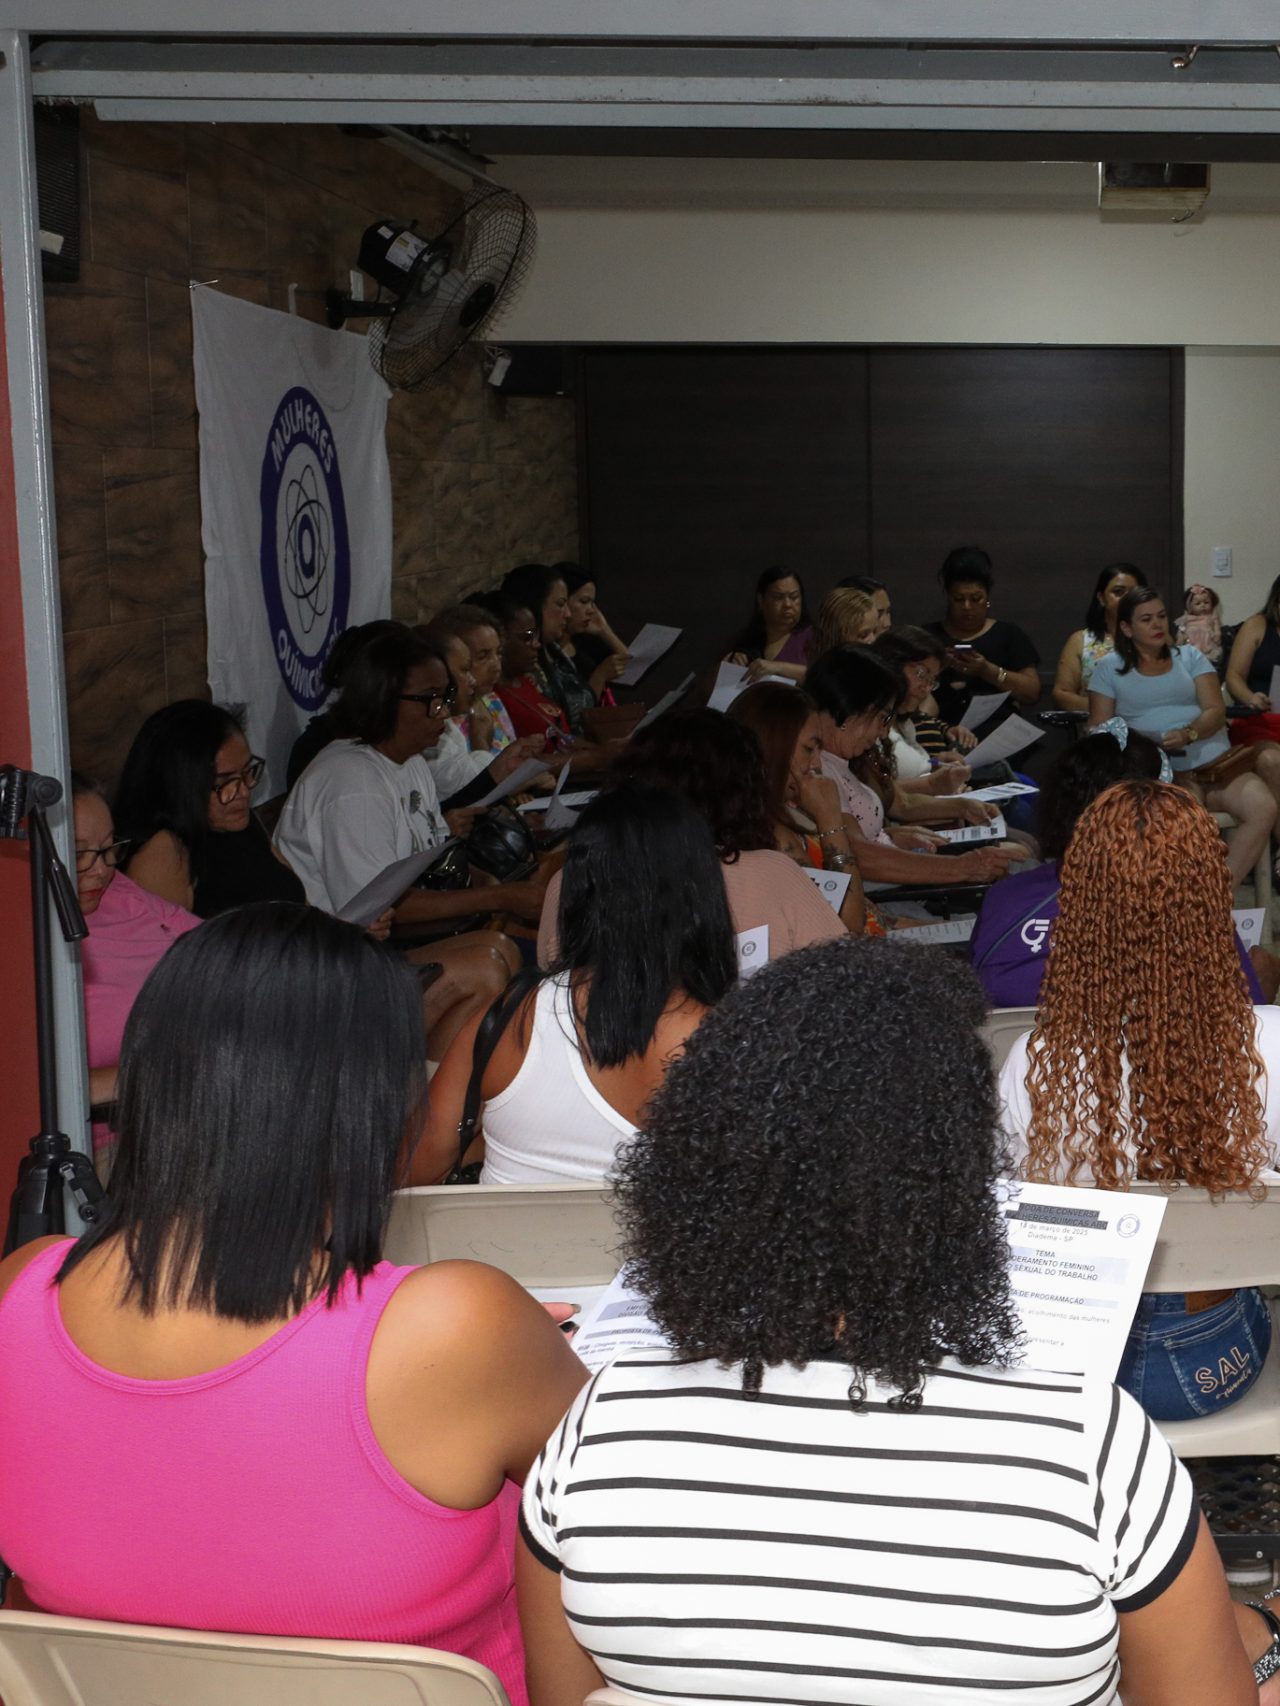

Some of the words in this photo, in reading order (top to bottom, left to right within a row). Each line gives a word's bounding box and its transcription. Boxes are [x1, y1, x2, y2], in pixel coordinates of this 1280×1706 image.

[271, 399, 334, 473] MULHERES
[1035, 1249, 1056, 1258] TEMA
[1013, 1264, 1043, 1275] SEXUAL
[1044, 1268, 1056, 1276] DO
[1057, 1270, 1098, 1281] TRABALHO
[1059, 1261, 1096, 1272] FEMININO
[1195, 1346, 1250, 1393] SAL
